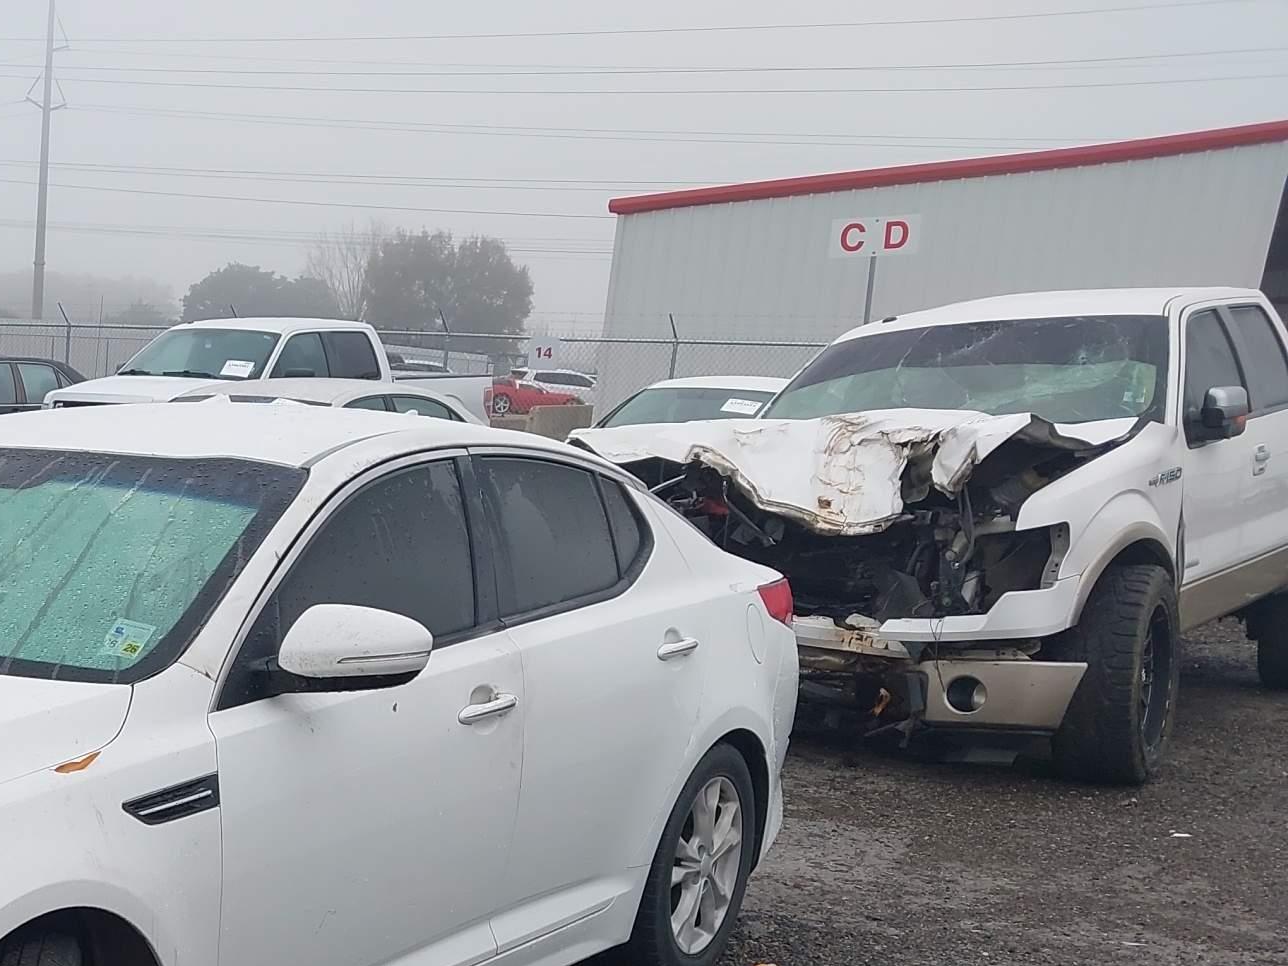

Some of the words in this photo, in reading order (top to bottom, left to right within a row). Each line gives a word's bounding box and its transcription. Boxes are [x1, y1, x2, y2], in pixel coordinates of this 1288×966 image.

[840, 222, 867, 252] C
[884, 220, 910, 250] D
[535, 346, 553, 359] 14
[122, 642, 141, 654] 26
